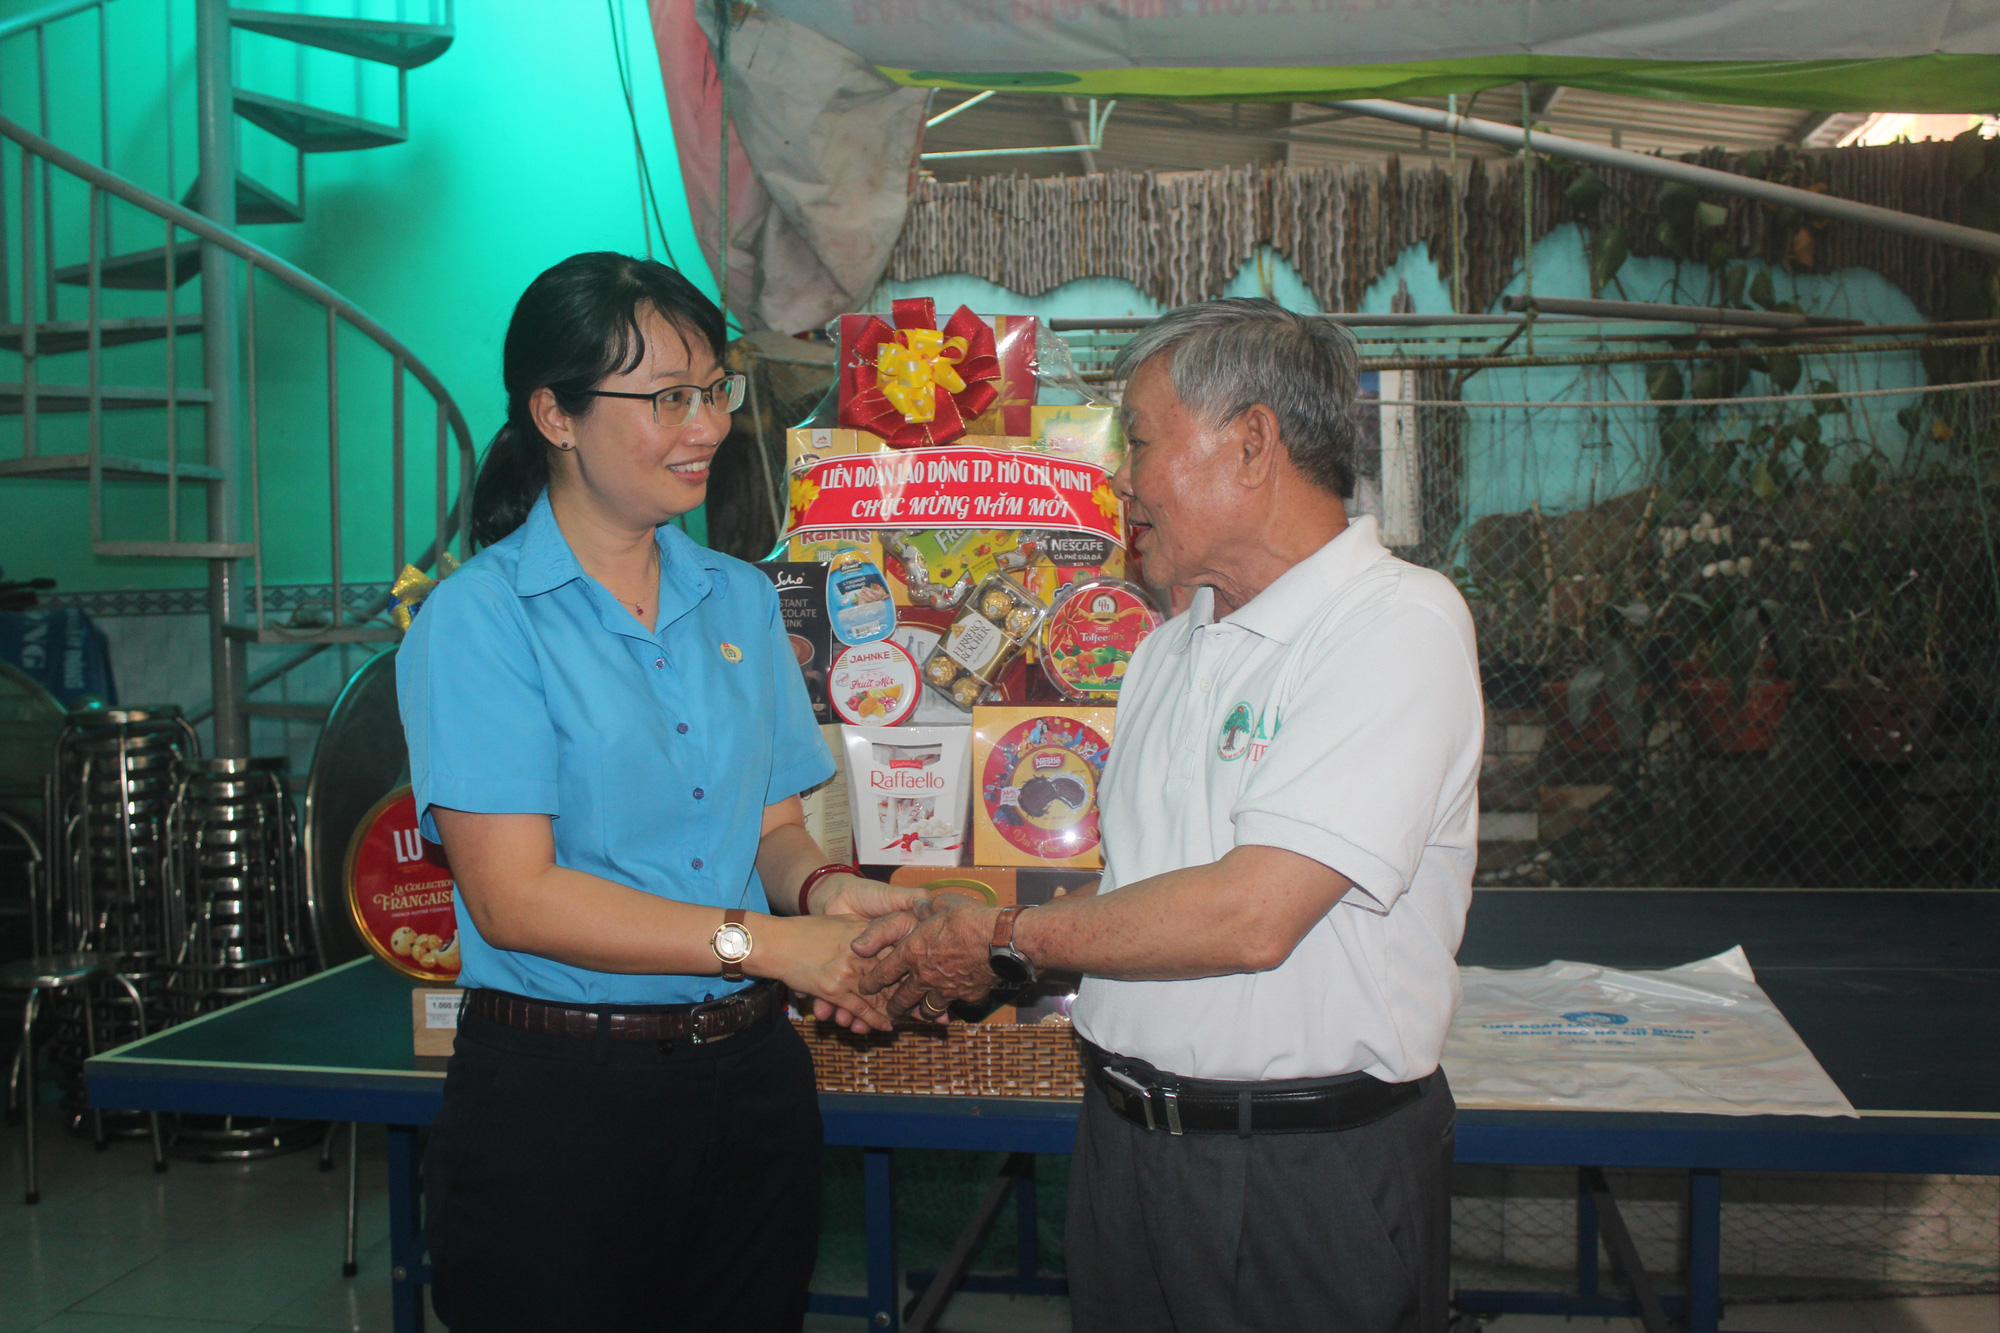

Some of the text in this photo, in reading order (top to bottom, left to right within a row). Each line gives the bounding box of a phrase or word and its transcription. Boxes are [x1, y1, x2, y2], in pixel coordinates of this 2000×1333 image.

[821, 455, 1092, 492] LIÊN ĐOÀN LAO ĐỘNG TP. HỒ CHÍ MINH
[851, 490, 1069, 519] CHÚC MỪNG NĂM MỚI
[779, 599, 808, 607] STANT
[781, 609, 817, 618] COLATE
[784, 619, 803, 628] RINK
[953, 619, 983, 657] FERRERO
[960, 626, 991, 662] ROCHER
[849, 650, 891, 664] JAHNKE
[849, 679, 874, 690] Fruit
[870, 770, 945, 790] Raffaello
[393, 828, 424, 863] LU
